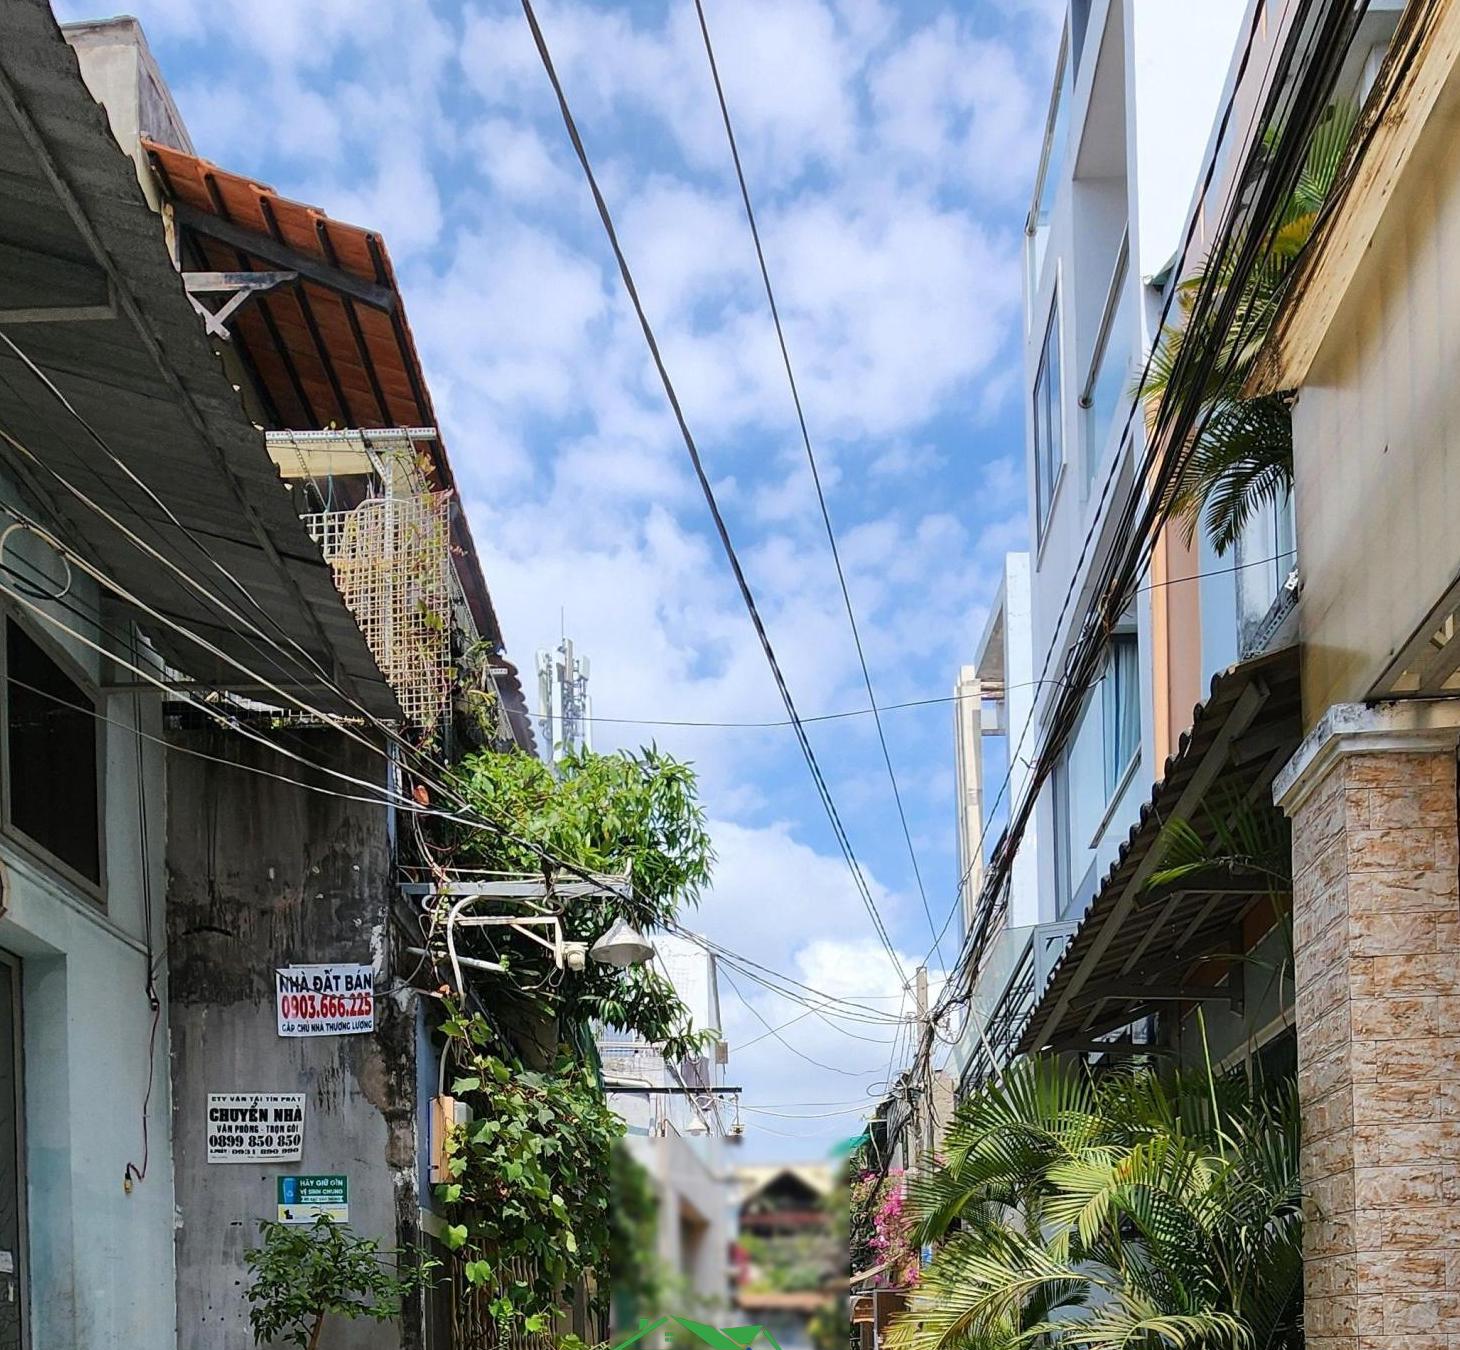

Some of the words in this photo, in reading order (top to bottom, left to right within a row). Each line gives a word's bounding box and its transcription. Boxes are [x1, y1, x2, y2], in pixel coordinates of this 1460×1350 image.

[280, 971, 309, 993] NHÀ
[345, 970, 372, 991] BÁN
[281, 992, 372, 1019] 0903.666.225
[209, 1100, 268, 1122] CHUYỂN
[273, 1104, 302, 1122] NHÀ
[209, 1134, 244, 1147] 0899
[248, 1134, 273, 1147] 850
[277, 1134, 301, 1147] 850
